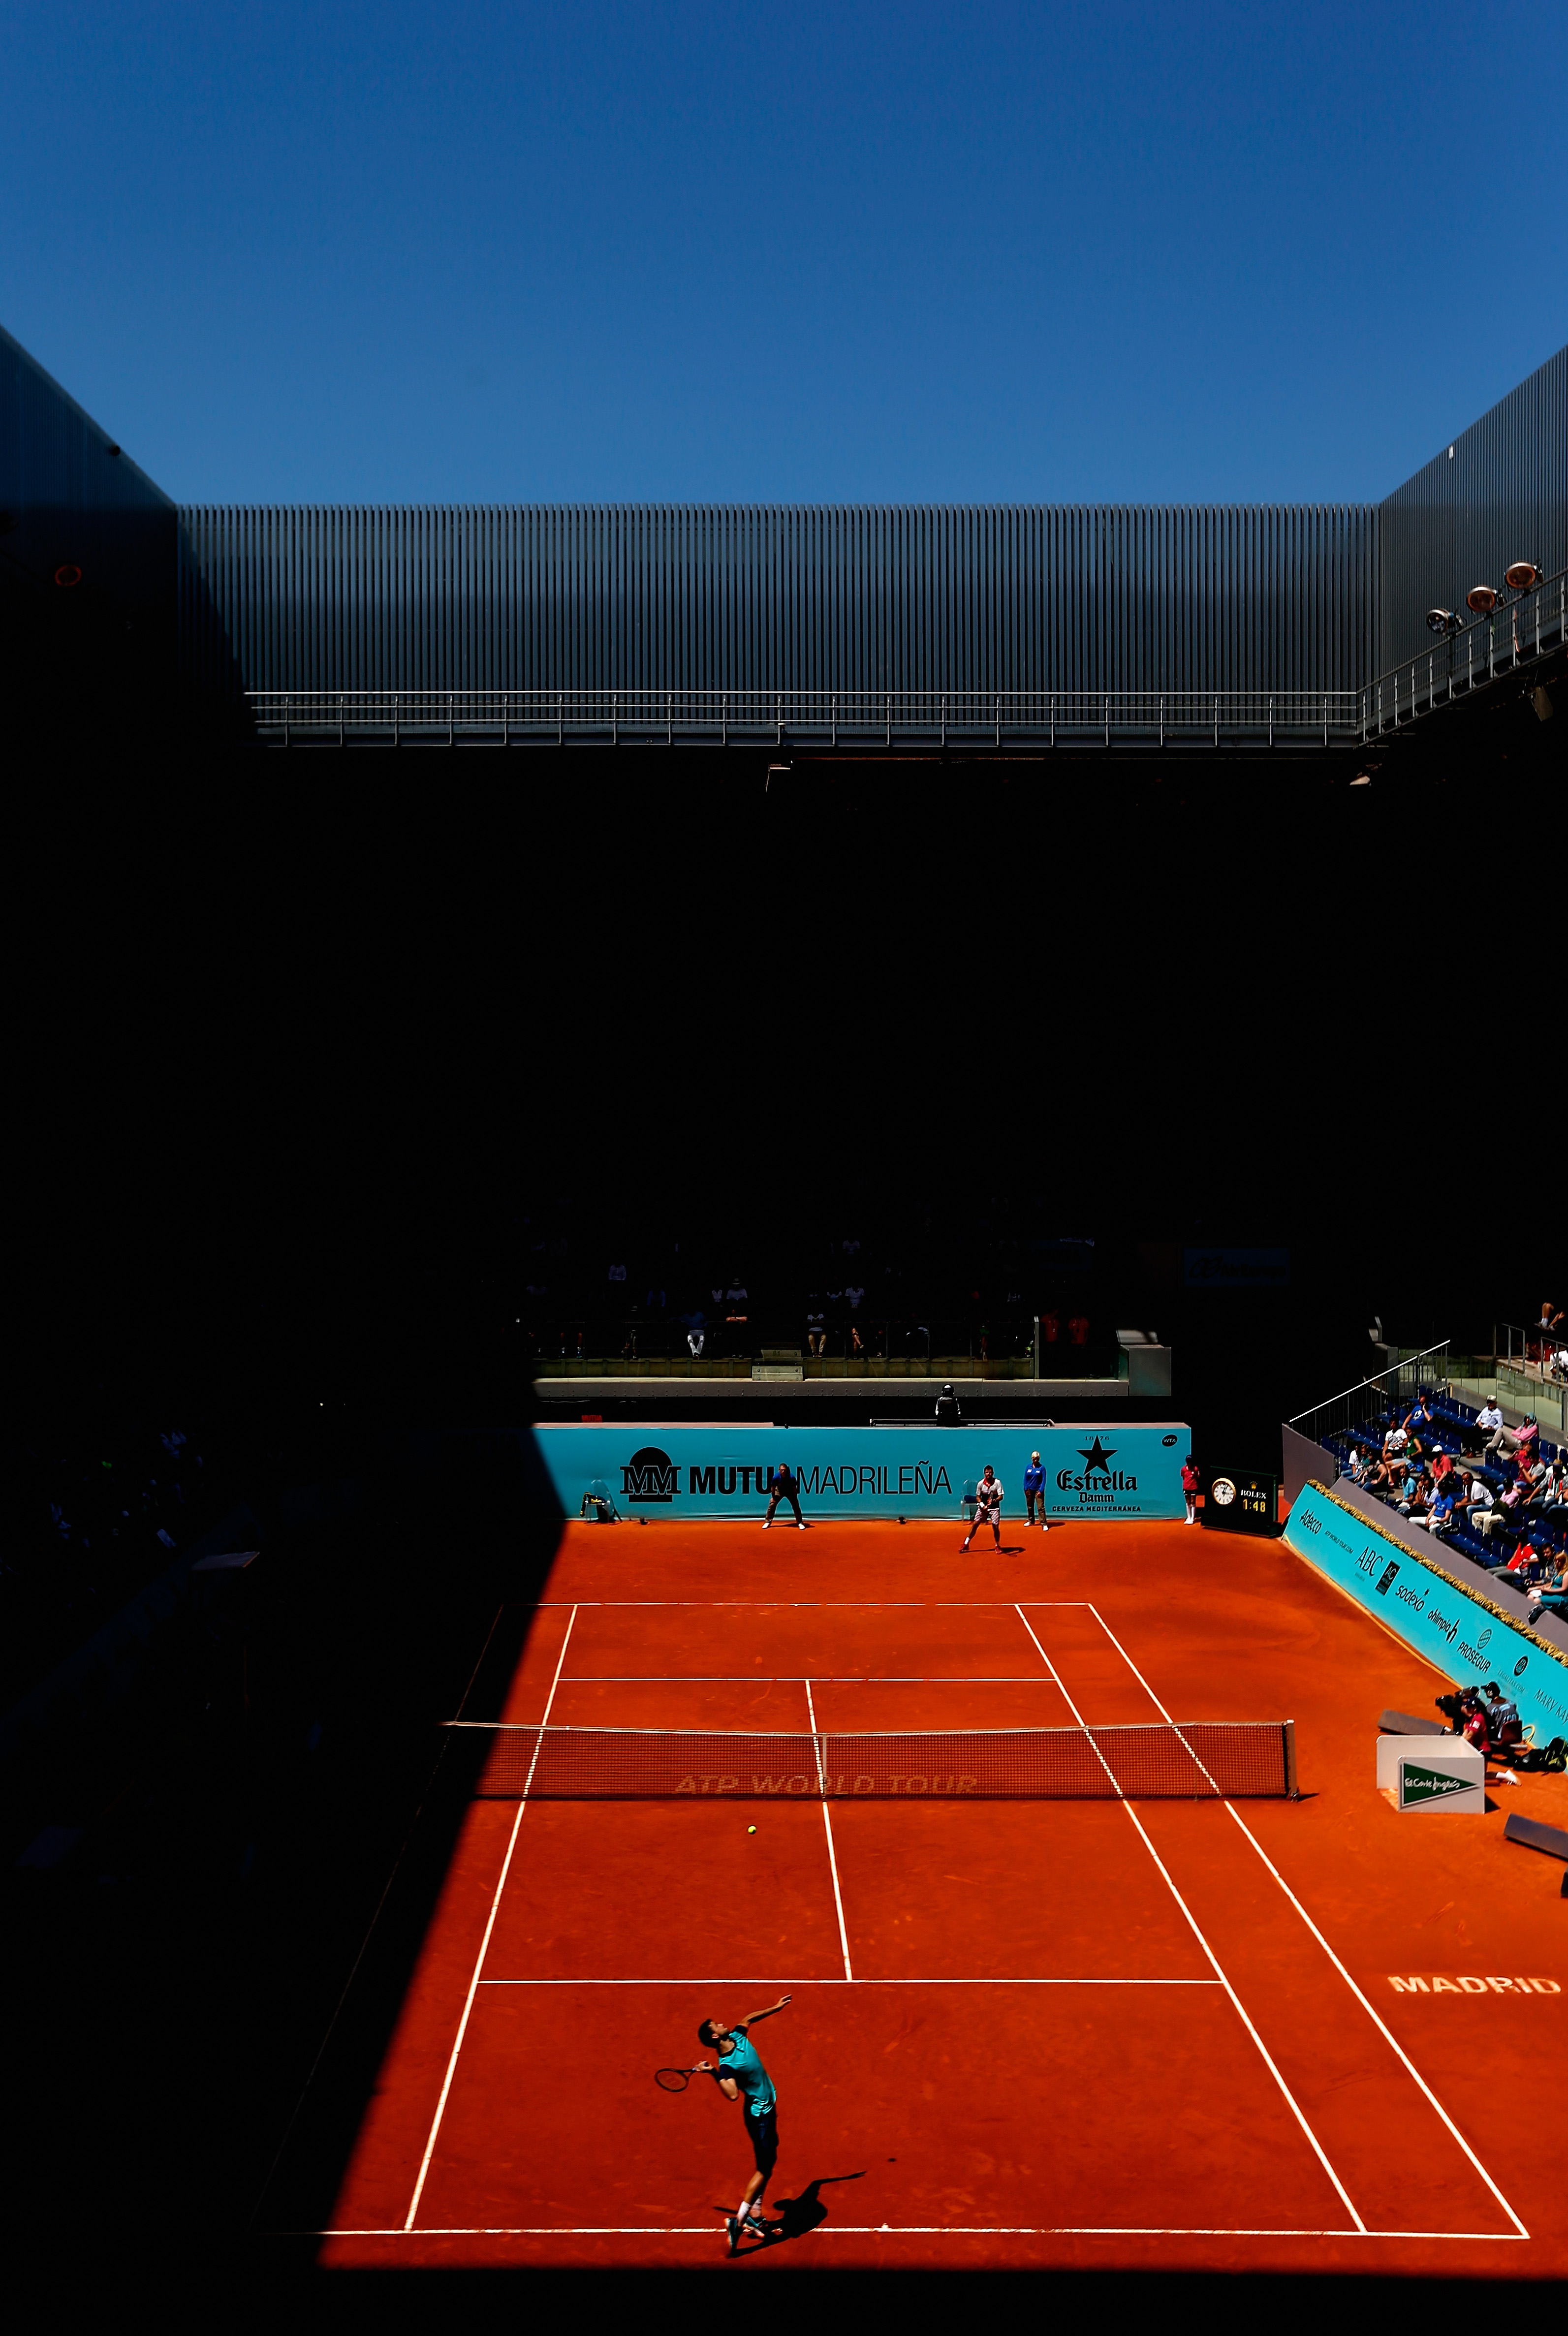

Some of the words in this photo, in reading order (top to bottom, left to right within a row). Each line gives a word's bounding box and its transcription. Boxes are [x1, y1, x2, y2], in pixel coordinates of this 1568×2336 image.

[690, 1466, 792, 1494] MUTU
[797, 1460, 952, 1494] MADRILEÑA
[1057, 1468, 1138, 1491] Estrella
[1079, 1492, 1114, 1503] Damm
[1241, 1490, 1266, 1499] ROLEX
[1243, 1499, 1265, 1512] 1:48
[1299, 1508, 1322, 1534] Adecco
[1354, 1546, 1383, 1576] ABC
[1395, 1585, 1425, 1612] sodexo
[1457, 1641, 1491, 1673] PROSEGUR
[1534, 1688, 1559, 1713] MARY
[674, 1775, 739, 1794] ATP
[888, 1775, 979, 1794] TOUR
[1387, 1976, 1562, 1993] MADRID
